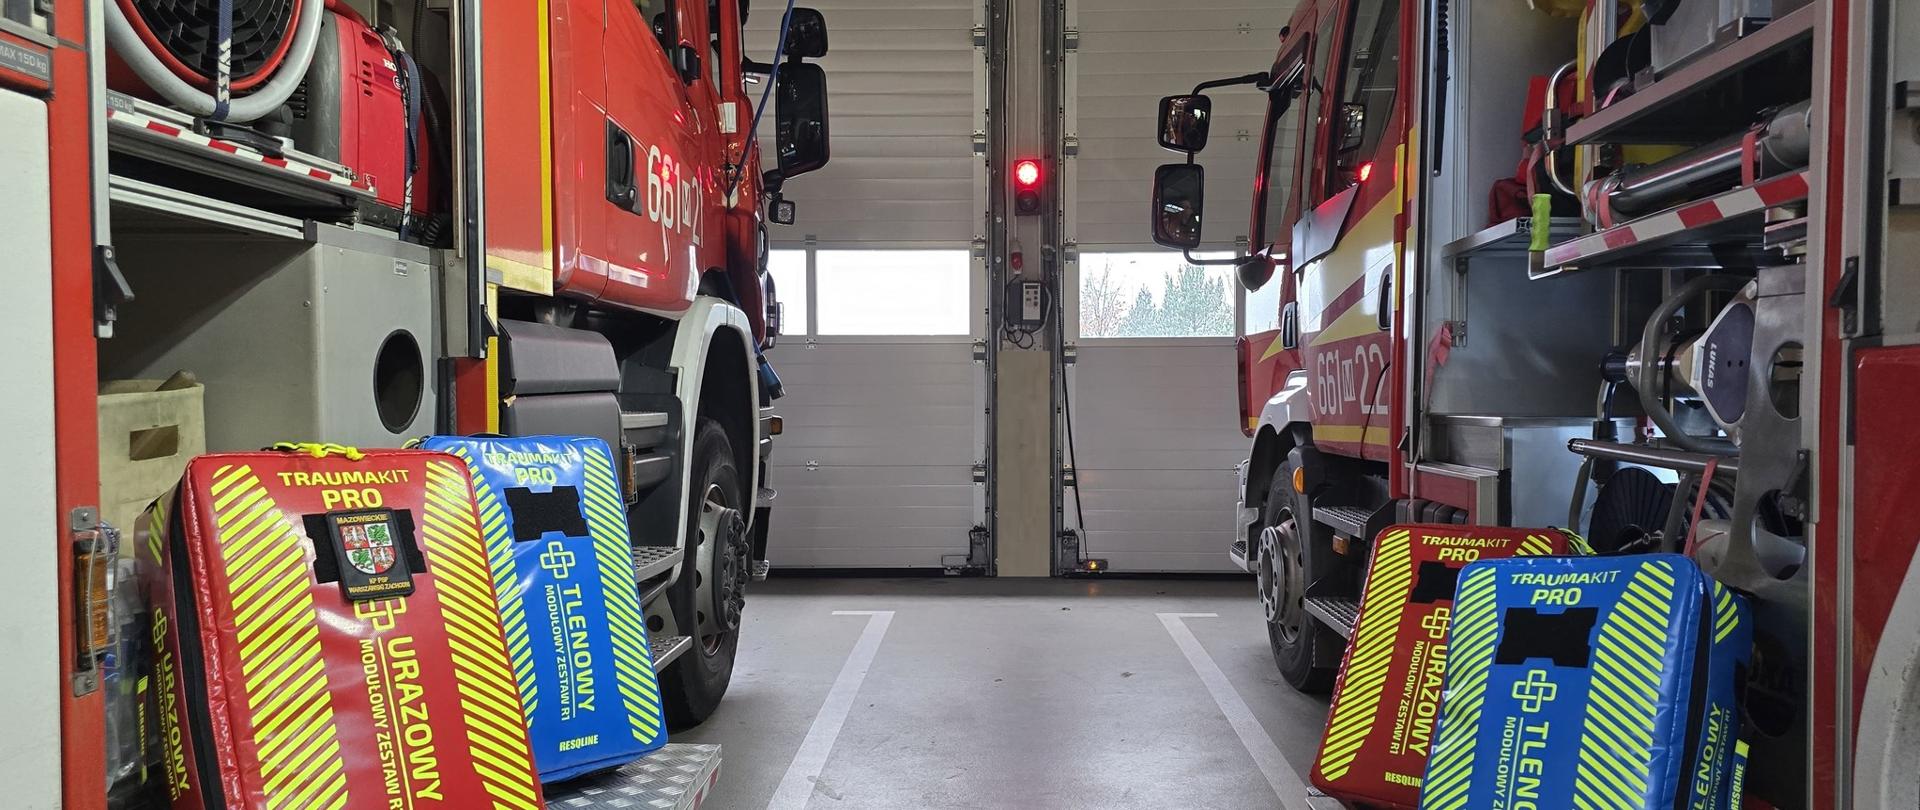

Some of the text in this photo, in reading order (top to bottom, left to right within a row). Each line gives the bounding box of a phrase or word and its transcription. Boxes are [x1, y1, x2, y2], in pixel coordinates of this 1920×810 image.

[18, 51, 36, 67] 150
[37, 57, 47, 73] kg
[648, 144, 680, 234] 661
[692, 175, 704, 249] 21
[1317, 348, 1343, 415] 661
[1355, 343, 1389, 415] 22
[1707, 342, 1718, 389] LUKAS
[486, 452, 572, 465] TRAUMAKIT
[515, 466, 557, 485] PRO
[277, 469, 409, 487] TRAUMAKIT
[321, 488, 383, 510] PRO
[1421, 535, 1511, 548] TRAUMAKIT
[1438, 547, 1480, 562] PRO
[1511, 570, 1621, 586] TRAUMAKIT
[1530, 587, 1582, 606] PRO
[545, 584, 571, 721] MODUŁOWY ZESTAW R1
[563, 583, 596, 712] TLENOWY
[1389, 640, 1424, 755] MODUŁOWY ZESTAW R1
[1409, 644, 1448, 757] URAZOWY
[163, 652, 190, 790] URAZOWY
[359, 638, 389, 728] MODUŁOWY
[376, 731, 401, 795] ZESTAW
[387, 636, 443, 801] URAZOWY
[559, 734, 599, 752] RESQLINE
[1495, 716, 1517, 798] MODUŁOWY
[1385, 771, 1423, 788] RESQLIN
